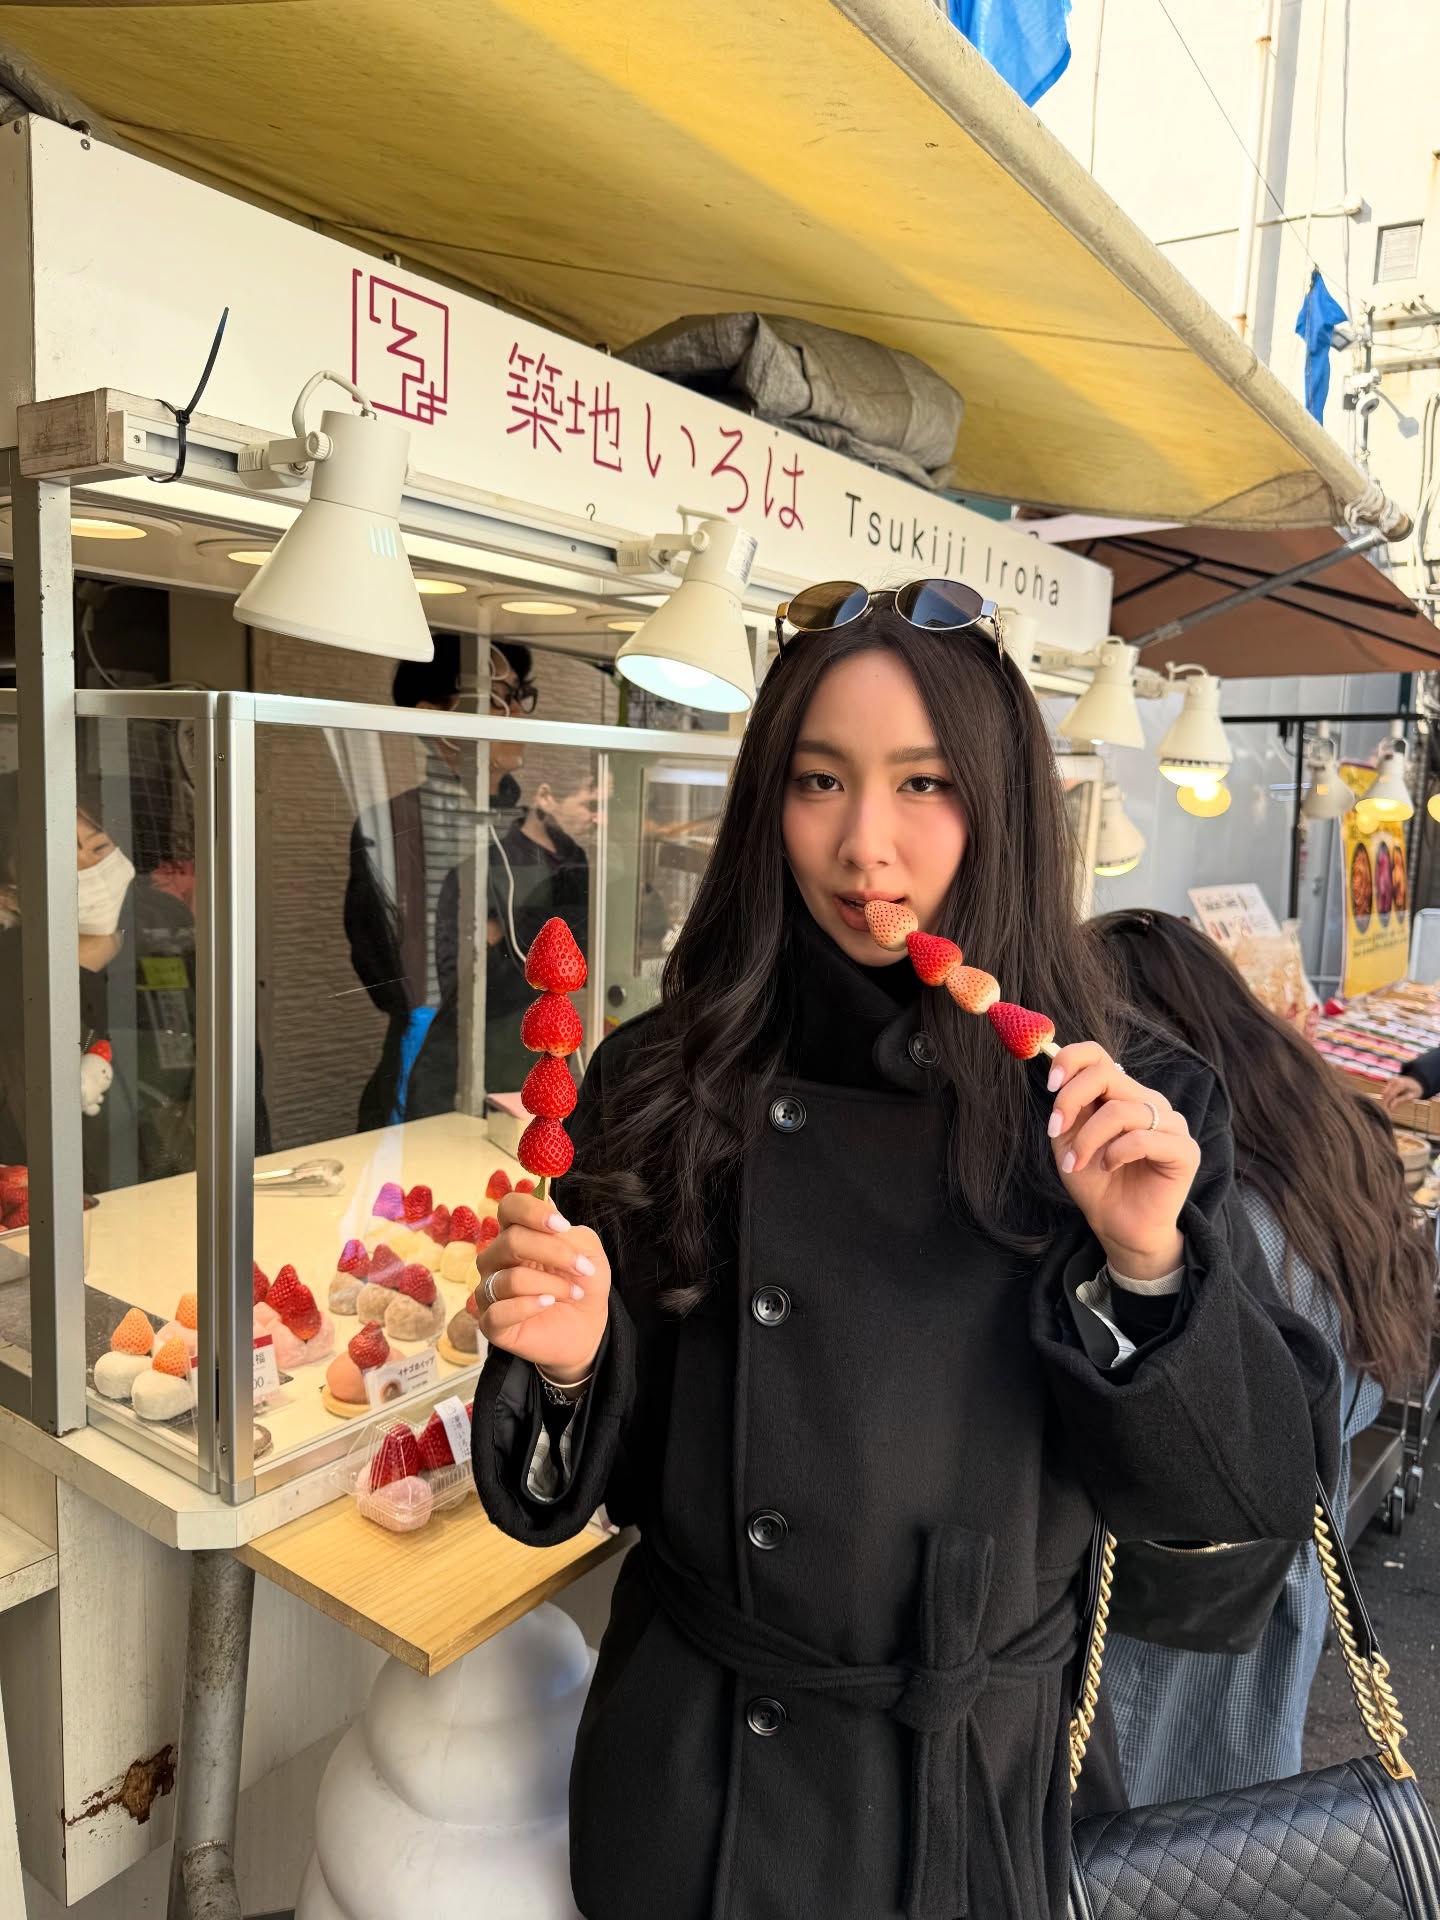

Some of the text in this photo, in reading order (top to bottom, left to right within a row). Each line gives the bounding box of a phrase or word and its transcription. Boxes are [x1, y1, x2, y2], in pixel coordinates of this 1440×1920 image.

[507, 343, 806, 531] 築地いろは
[845, 492, 1060, 606] Tsukiji Iroha
